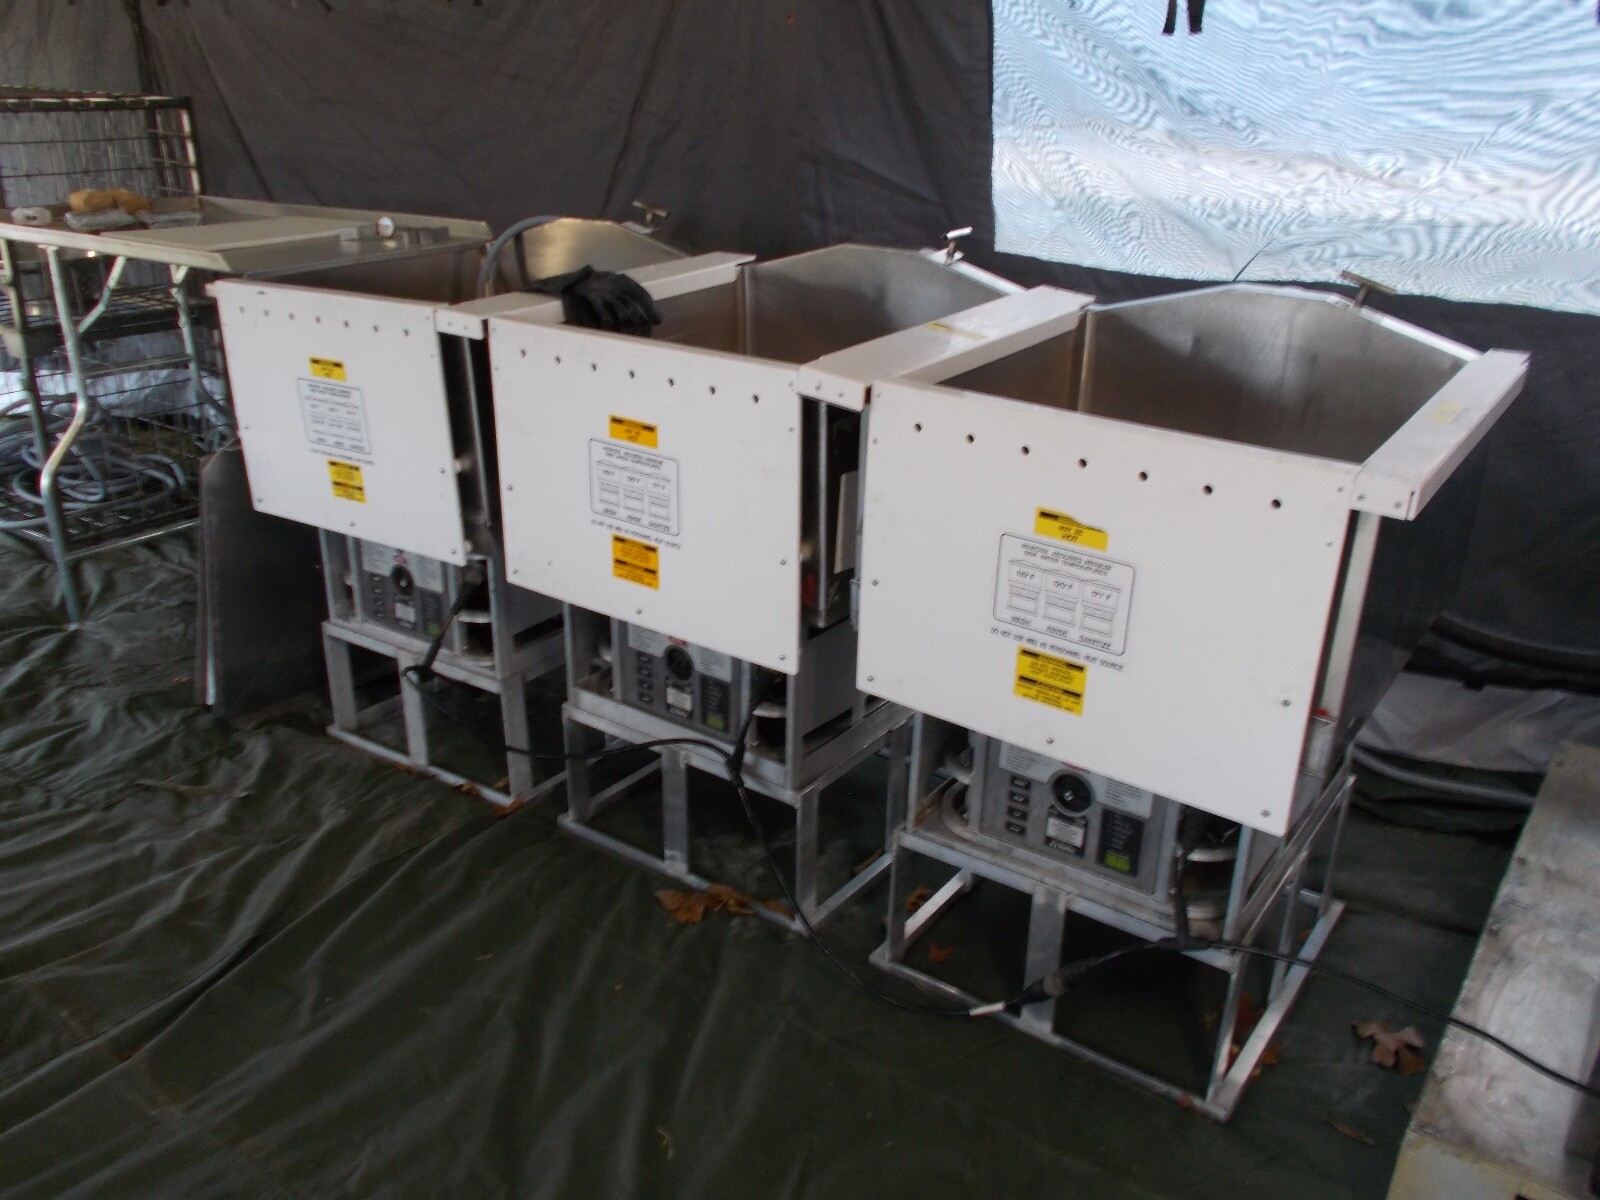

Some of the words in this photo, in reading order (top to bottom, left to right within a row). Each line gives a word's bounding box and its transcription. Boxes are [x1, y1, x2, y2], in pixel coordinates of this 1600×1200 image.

[1062, 532, 1078, 543] HOT
[1046, 626, 1068, 638] RINSE
[1078, 634, 1112, 650] SANITIZE
[1048, 644, 1082, 659] PERSONNEL
[1098, 658, 1124, 671] SOURCE
